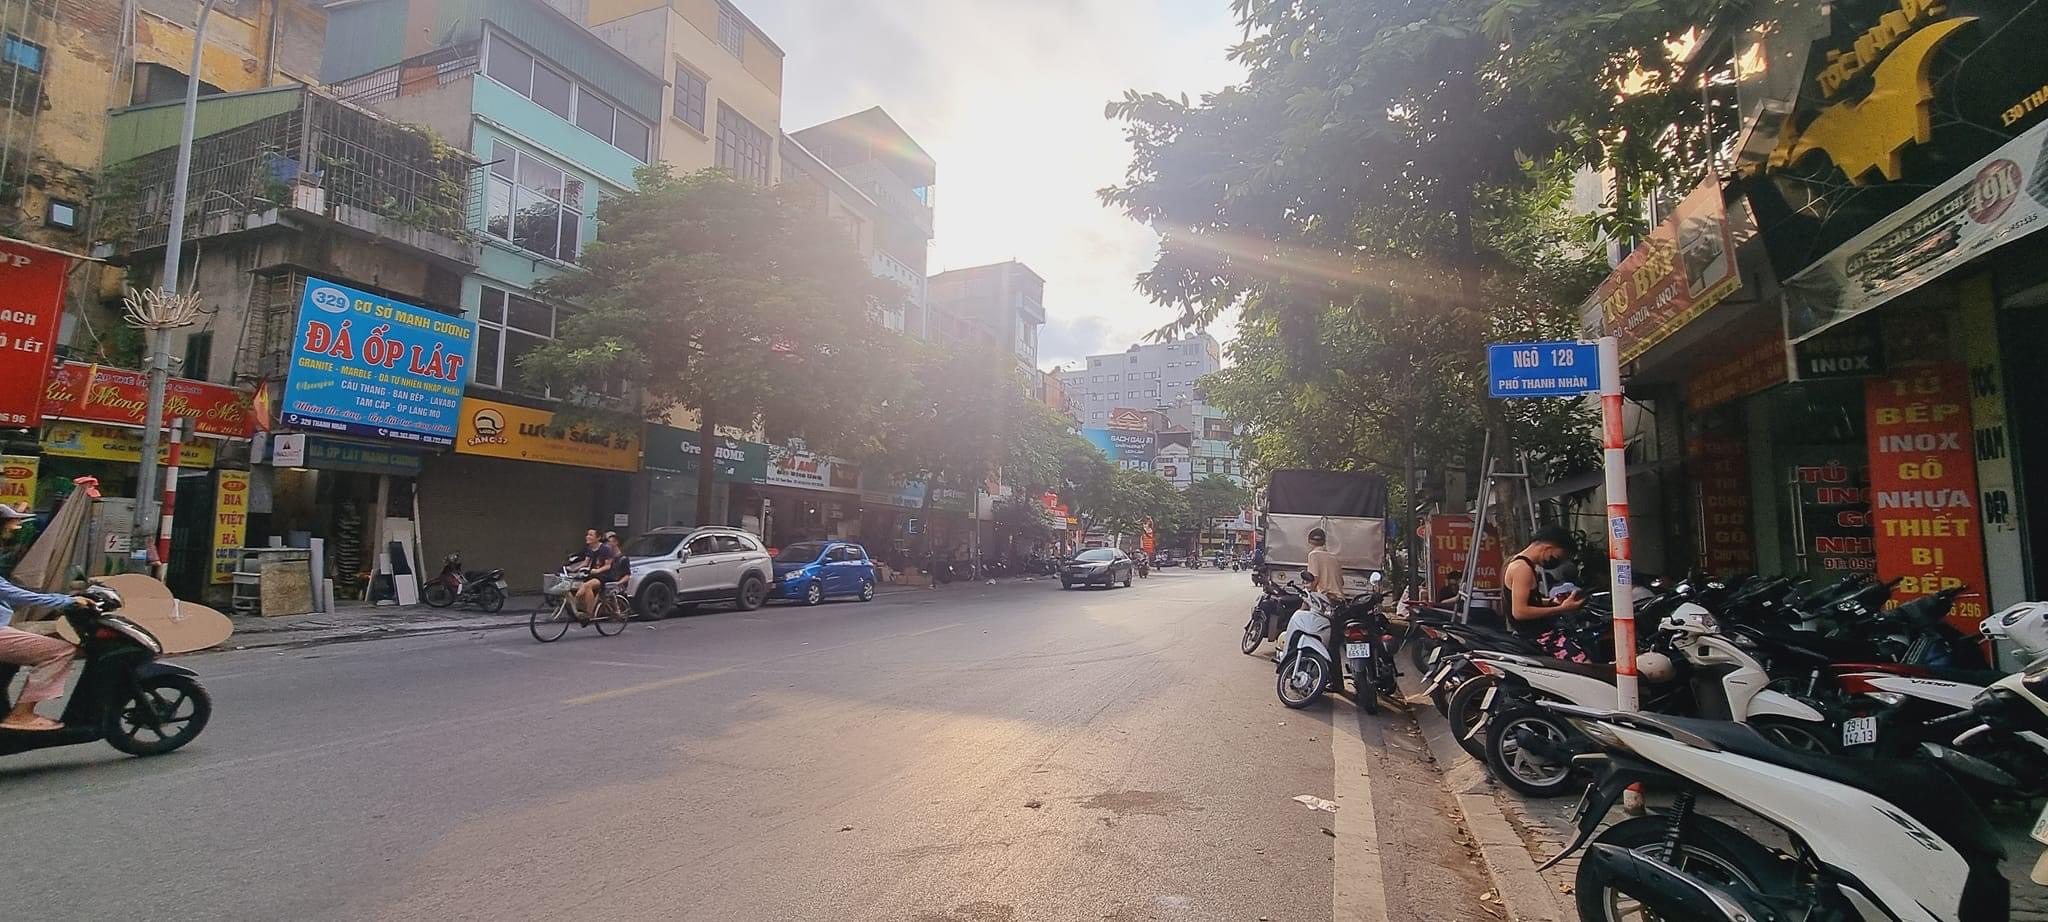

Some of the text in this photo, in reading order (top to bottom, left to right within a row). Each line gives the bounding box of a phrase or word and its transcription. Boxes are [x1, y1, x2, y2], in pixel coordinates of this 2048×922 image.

[2001, 103, 2024, 127] 130
[315, 291, 346, 310] 329
[395, 310, 431, 330] MẠNH
[433, 320, 471, 340] CƯỜNG
[304, 319, 465, 382] ĐÁ ỐP LÁT
[1513, 346, 1575, 369] NGÕ 128
[298, 357, 335, 373] GRANITE
[340, 364, 373, 380] MARBLE
[1811, 354, 1872, 374] INOX
[1498, 375, 1588, 391] PHỐ THANH NHÀN
[360, 383, 387, 397] THANG
[430, 396, 458, 410] LAVABO
[1876, 400, 1960, 426] BẾP
[714, 446, 746, 462] HOME
[1878, 431, 1961, 454] INOX
[1898, 455, 1944, 481] GỖ
[223, 494, 242, 506] BIA
[1877, 488, 1972, 513] NHỰA
[219, 510, 246, 529] VIỆT
[1881, 511, 1970, 538] THIẾT
[1436, 529, 1457, 551] TỦ
[1910, 546, 1945, 572] BỊ
[1898, 570, 1963, 595] BẾP
[1960, 601, 1982, 619] 296
